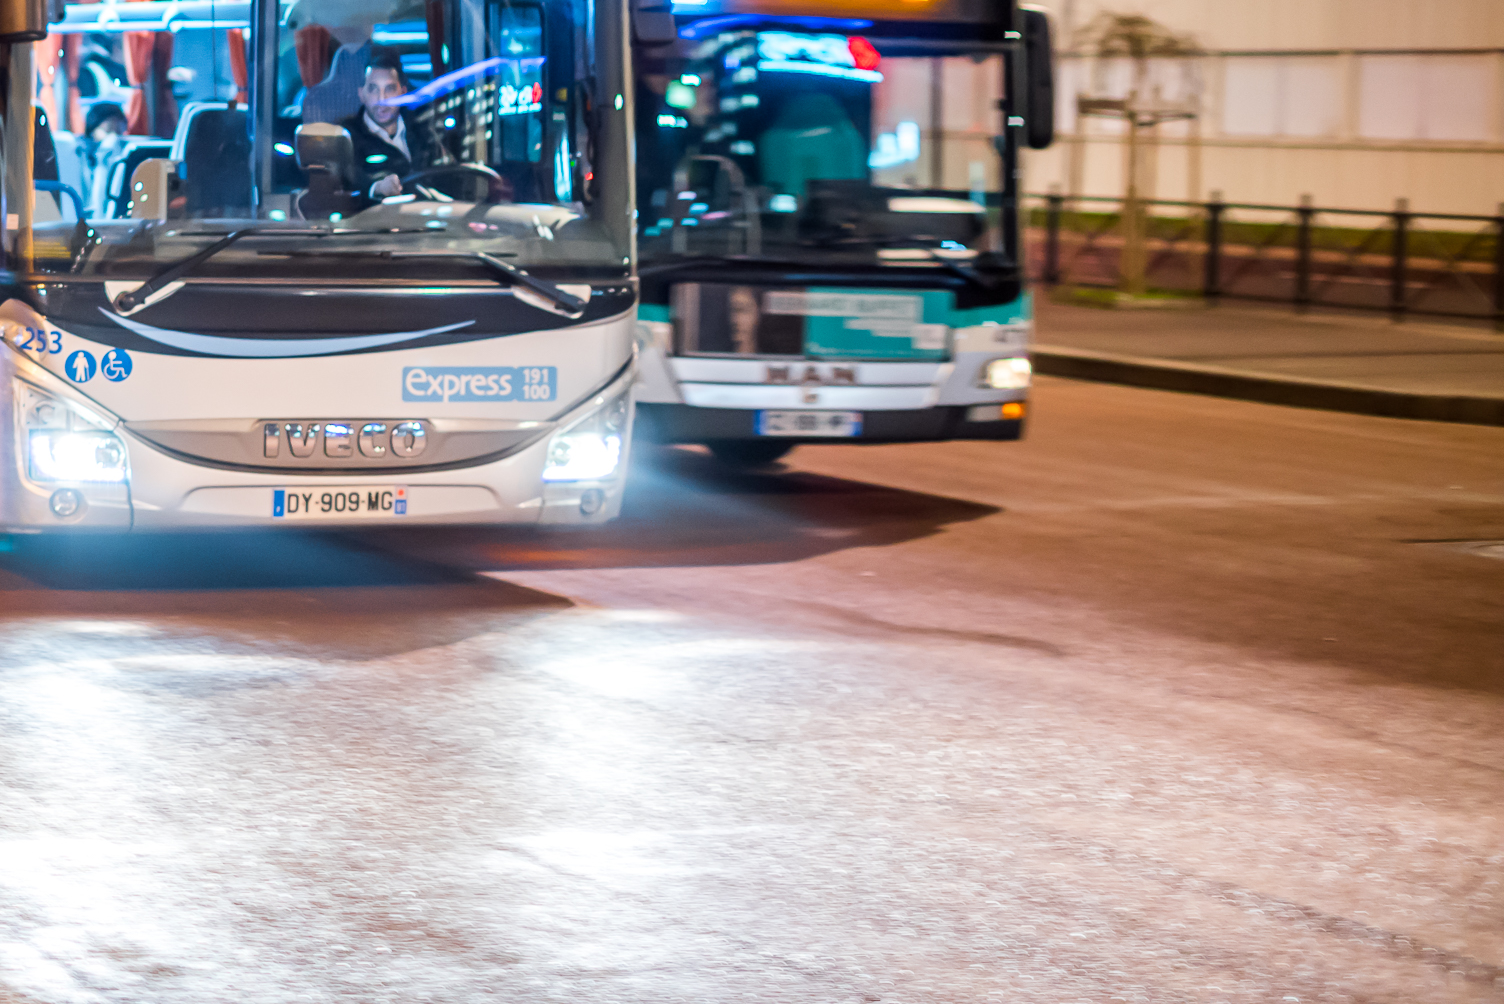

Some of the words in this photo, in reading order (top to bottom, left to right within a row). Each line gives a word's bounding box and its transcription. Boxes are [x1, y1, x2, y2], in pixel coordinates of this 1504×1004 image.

[20, 327, 63, 354] 253
[405, 368, 512, 403] express
[523, 368, 549, 384] 191
[522, 384, 550, 400] 100
[263, 422, 427, 459] IVECO
[287, 492, 393, 514] DY-909-MG
